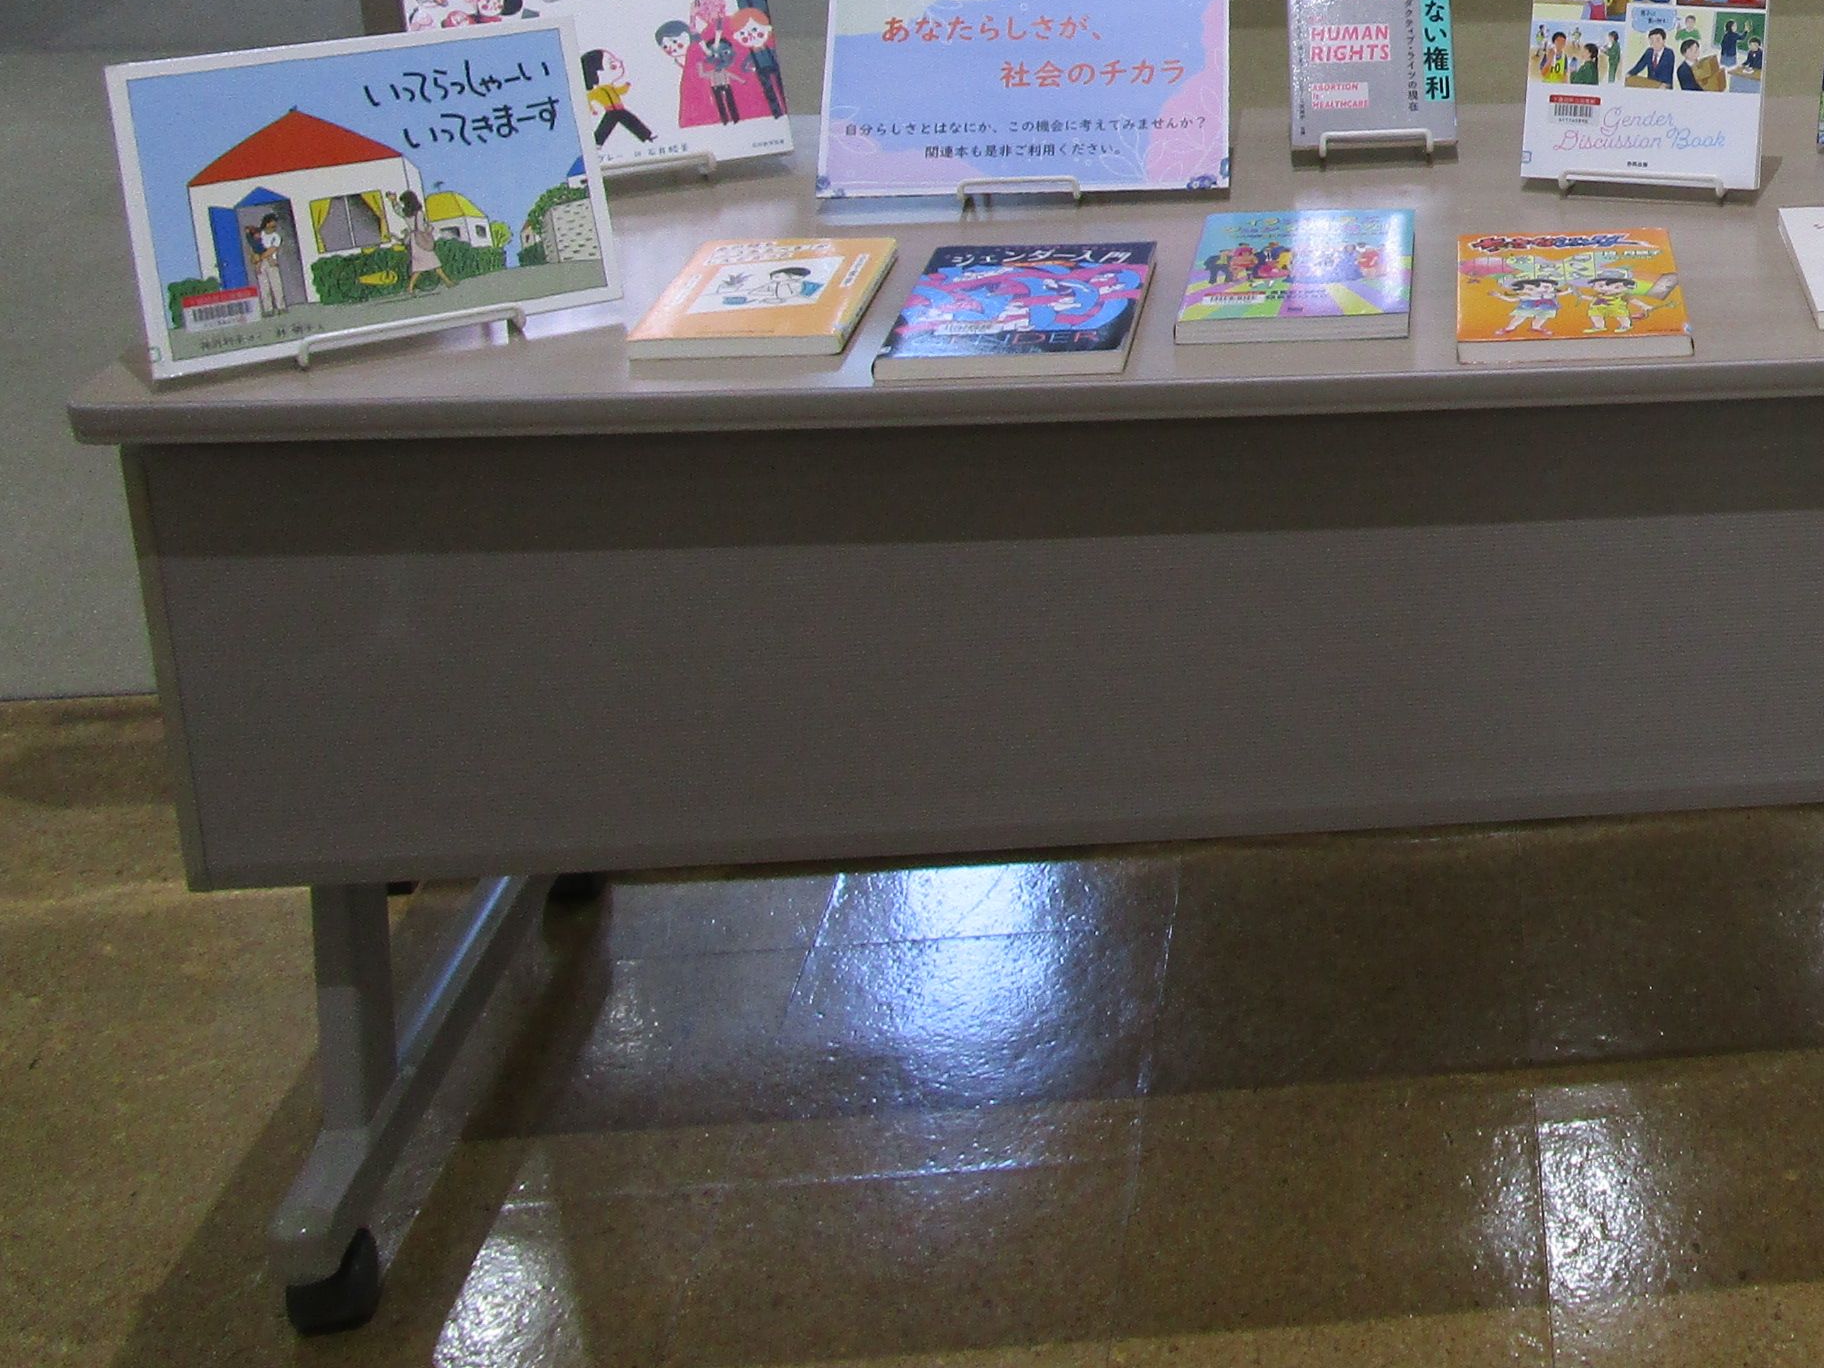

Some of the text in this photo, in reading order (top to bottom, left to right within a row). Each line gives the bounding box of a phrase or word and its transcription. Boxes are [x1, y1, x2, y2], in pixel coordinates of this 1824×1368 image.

[881, 16, 1102, 43] あなたらしさが、
[1310, 25, 1389, 42] HUMAN
[1310, 44, 1390, 62] RIGHTS
[364, 59, 550, 107] いってらっしゃーい
[1000, 59, 1187, 89] 社会のチカラ
[403, 95, 559, 149] いってきまーす
[1601, 106, 1674, 135] Gender
[924, 143, 1122, 160] 関連本も是非ご利用ください。
[1553, 125, 1726, 152] Discussion Book
